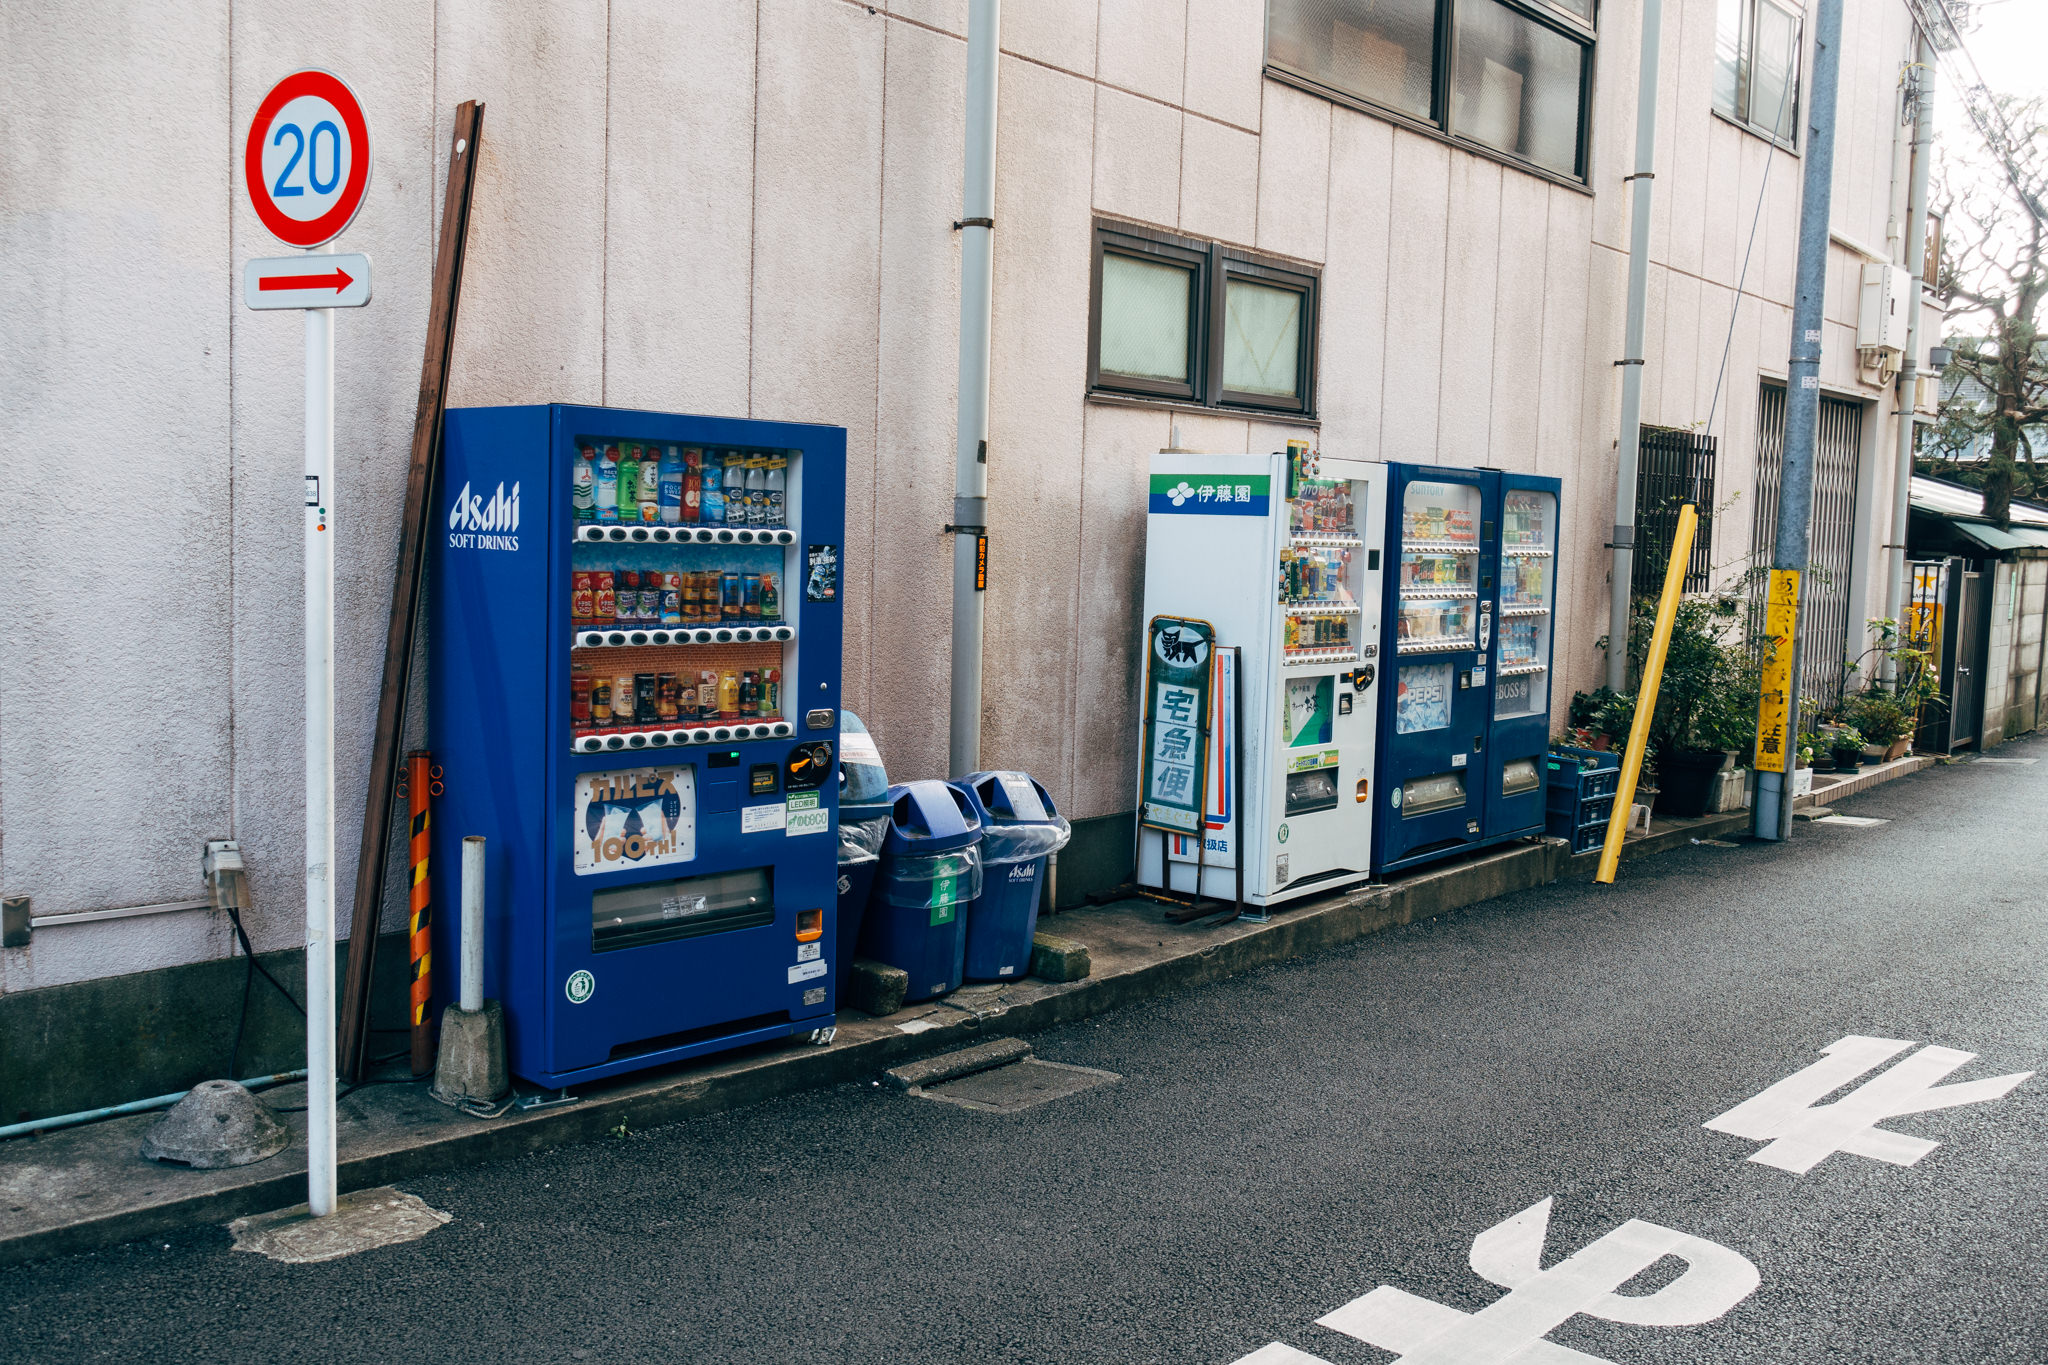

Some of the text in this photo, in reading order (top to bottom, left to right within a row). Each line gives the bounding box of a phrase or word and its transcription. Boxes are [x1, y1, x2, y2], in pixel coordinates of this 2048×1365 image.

[273, 120, 341, 197] 20
[1197, 485, 1251, 503] 伊藤園
[1411, 483, 1445, 497] SUNTORY
[449, 480, 520, 533] Asahi
[449, 533, 519, 551] SOFT DRINKS
[977, 538, 986, 588] 防犯カメラ設置
[1407, 685, 1444, 704] PEPSI
[1499, 681, 1519, 699] BOSS
[1157, 689, 1195, 801] 宅急便
[589, 771, 678, 803] カルピス
[790, 799, 816, 809] LED照明
[1152, 806, 1192, 824] やまぐち
[591, 830, 677, 863] 100TH!
[1008, 863, 1036, 879] Asahi
